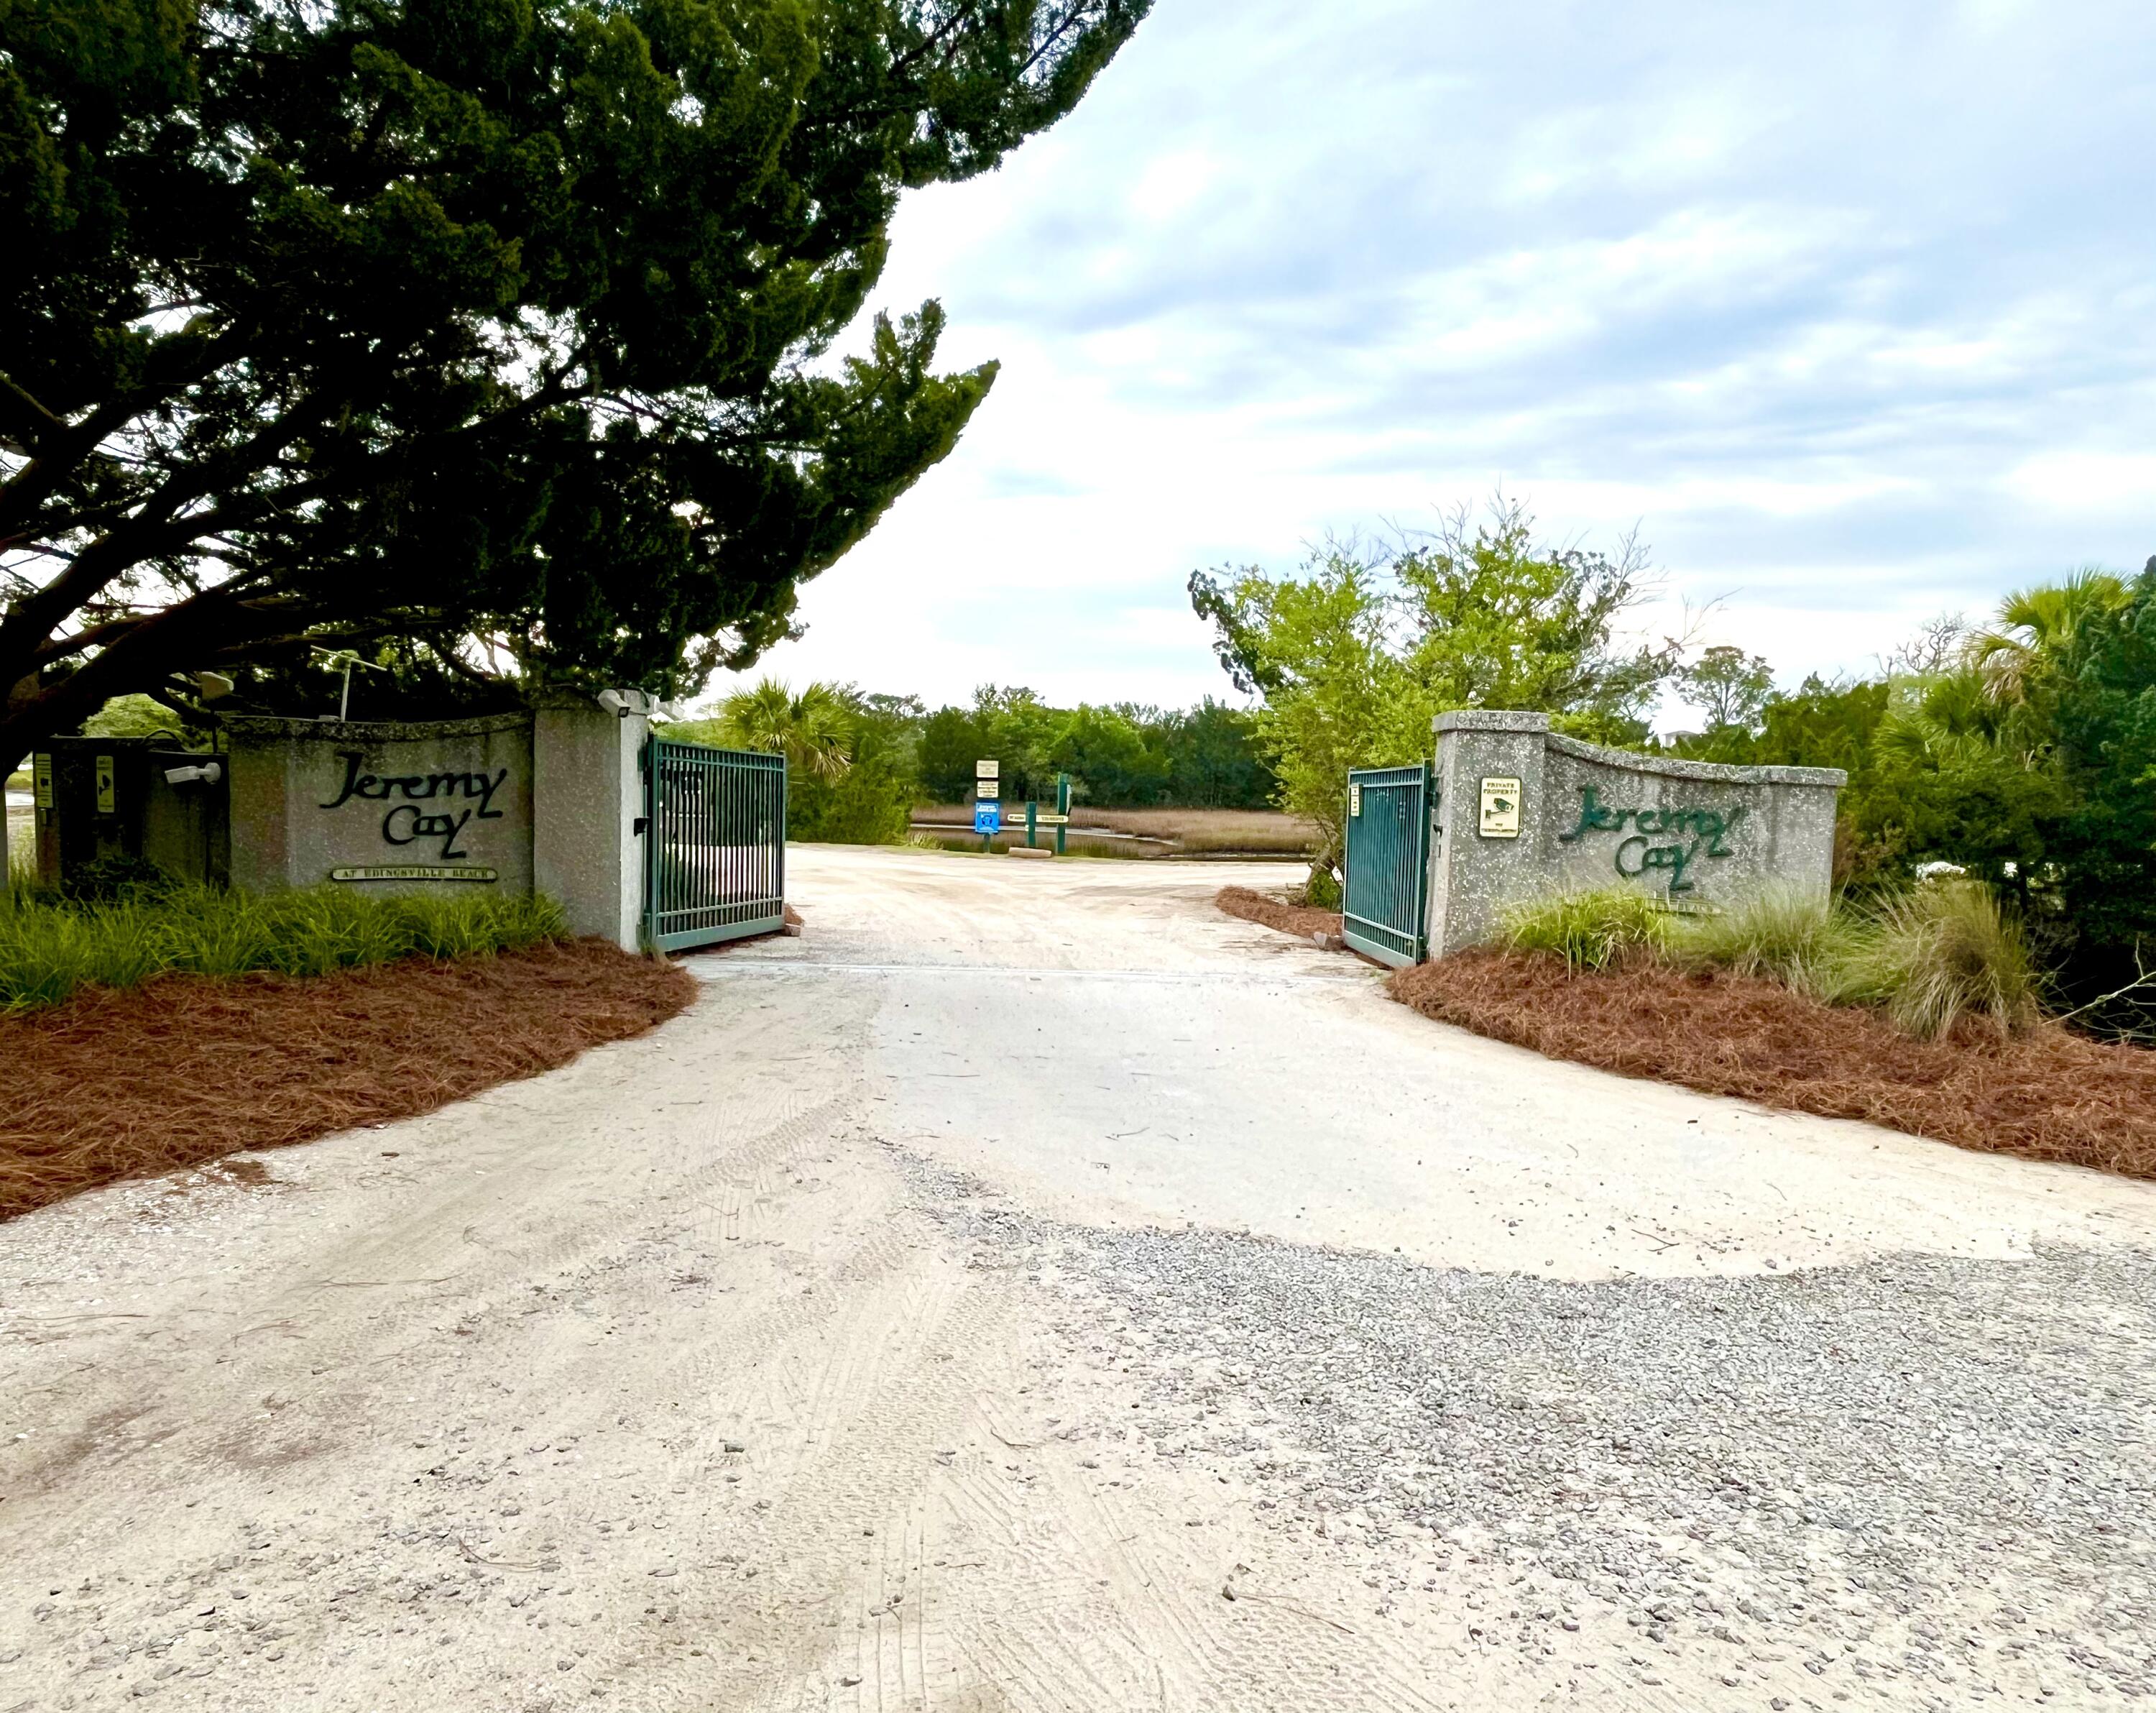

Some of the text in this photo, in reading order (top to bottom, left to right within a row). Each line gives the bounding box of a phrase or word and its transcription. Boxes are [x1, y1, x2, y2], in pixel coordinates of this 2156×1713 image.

[319, 751, 507, 818] Jeremy
[382, 805, 471, 860] Cay
[1559, 784, 1747, 857] Jeremy
[343, 869, 356, 878] AT
[453, 869, 488, 878] BEACH
[1615, 836, 1700, 891] Cay
